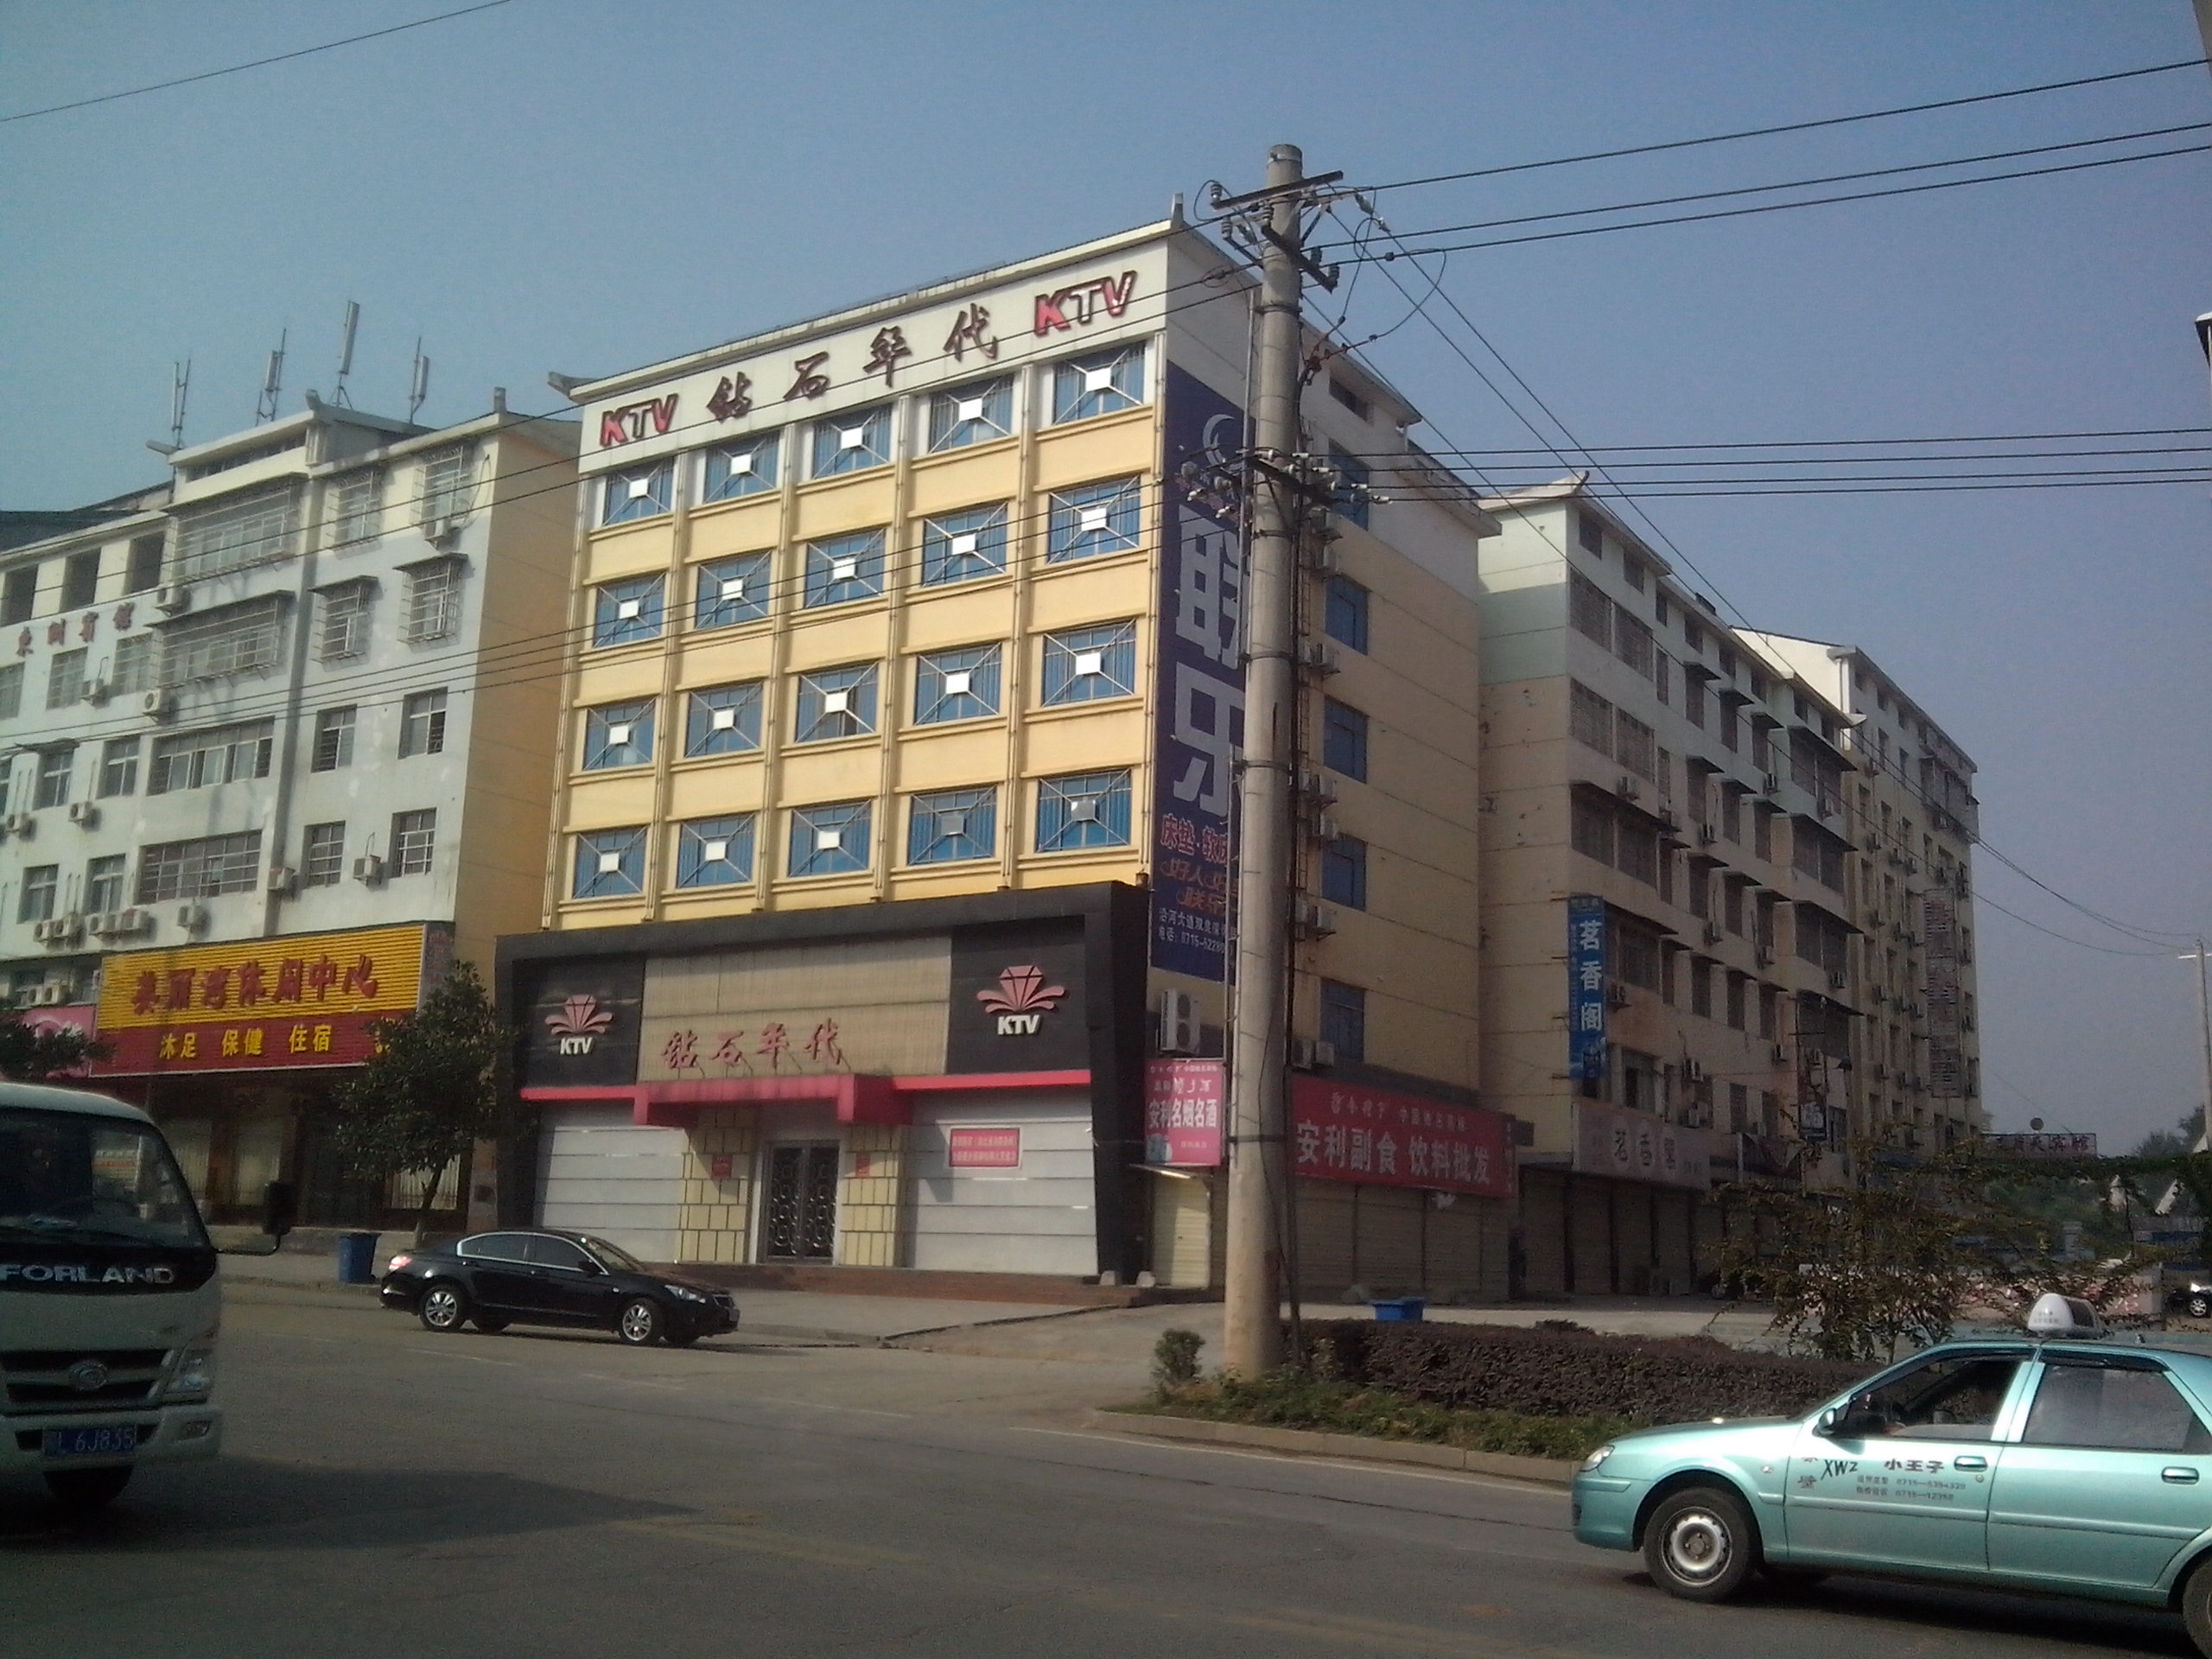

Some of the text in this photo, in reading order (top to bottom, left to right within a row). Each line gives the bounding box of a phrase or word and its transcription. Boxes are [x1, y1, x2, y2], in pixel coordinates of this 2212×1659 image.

[599, 270, 1138, 448] KTV 钻石年代 KTV
[1580, 919, 1603, 1032] 茗香阁
[159, 1024, 333, 1059] 沐足 保健 住宿
[997, 1014, 1040, 1035] KTV
[559, 1036, 594, 1055] KTV
[661, 1017, 844, 1070] 钻石年代
[1297, 1120, 1397, 1175] 安利副食
[0, 1264, 175, 1284] FORLAND
[1884, 1458, 1945, 1474] 小王子
